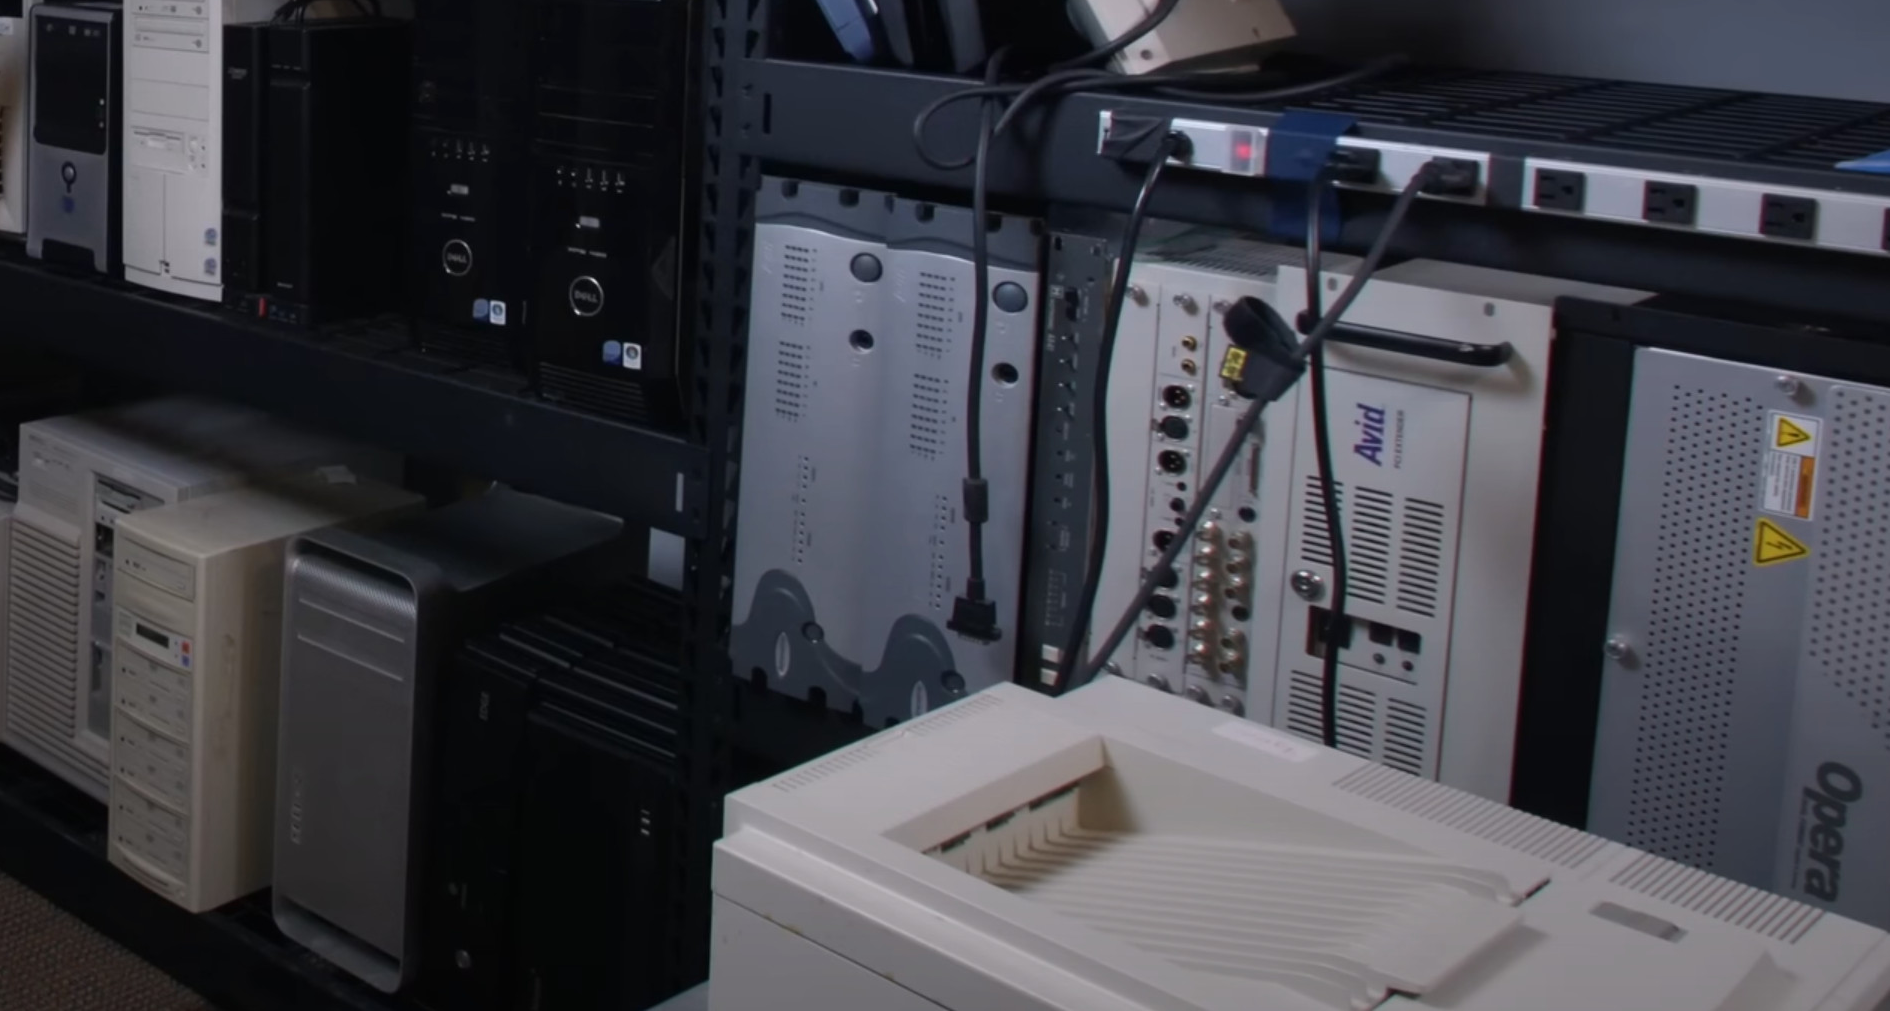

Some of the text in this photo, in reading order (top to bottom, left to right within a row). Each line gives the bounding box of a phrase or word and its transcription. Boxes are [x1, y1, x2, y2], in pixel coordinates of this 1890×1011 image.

[447, 251, 467, 264] DELL
[574, 289, 599, 303] DELL
[1354, 402, 1385, 467] Avid
[1804, 761, 1862, 903] Opera
